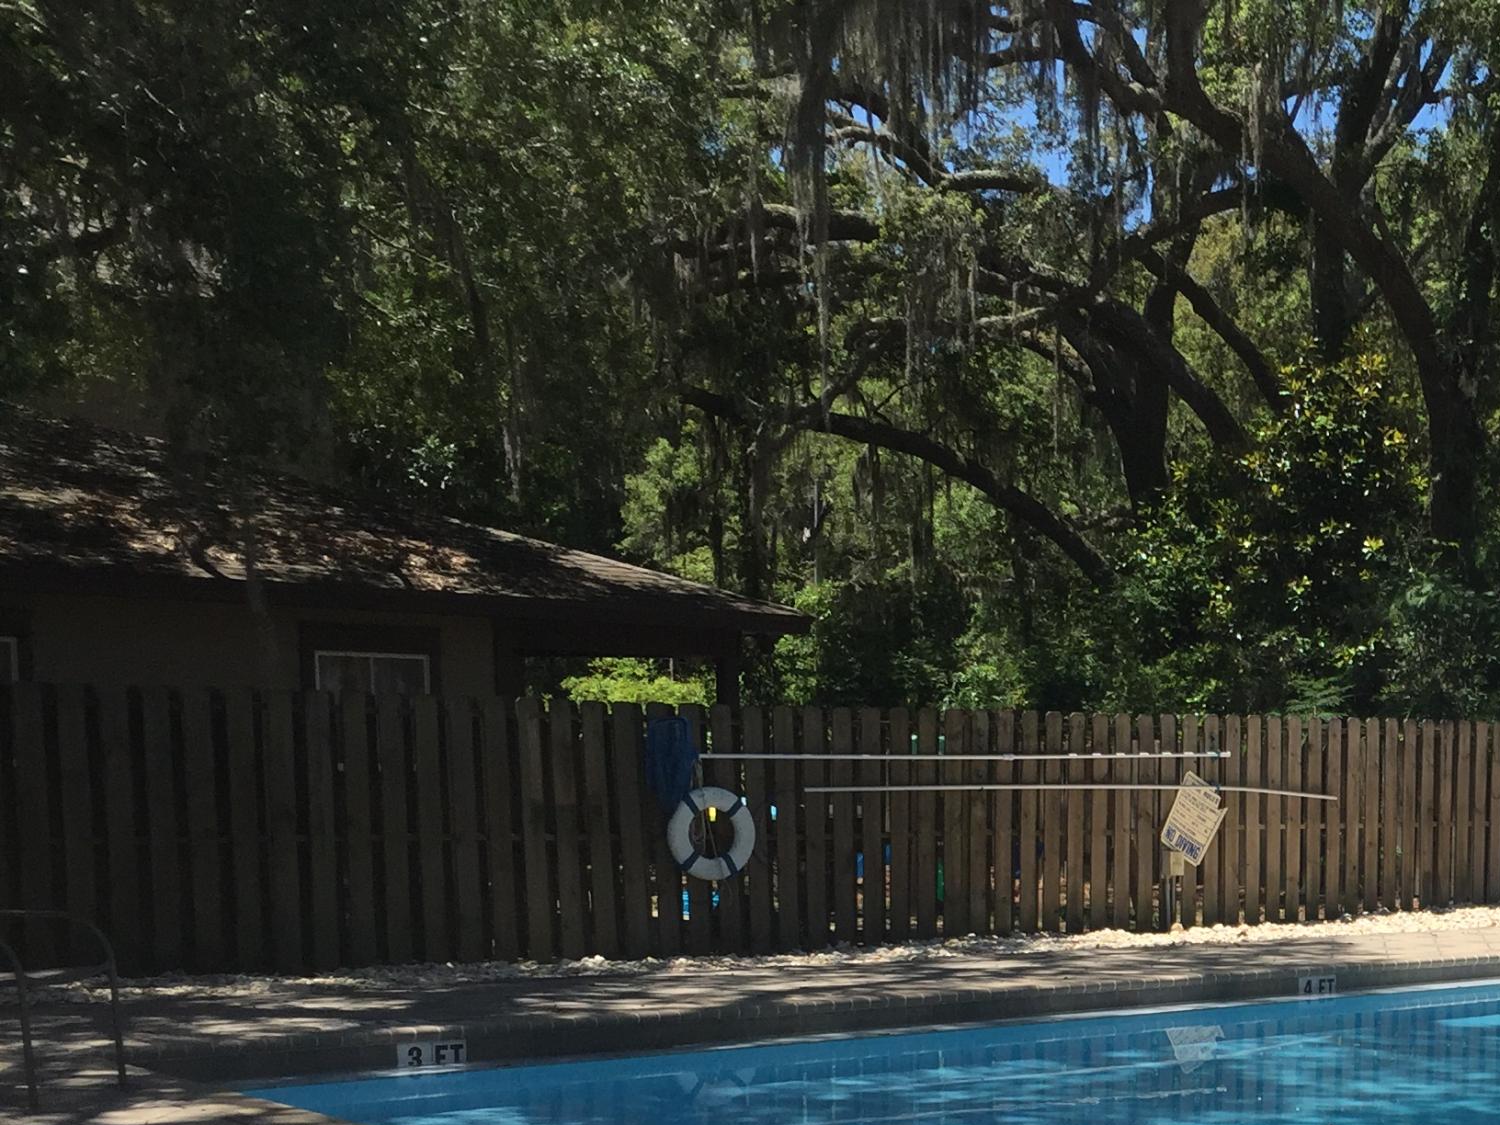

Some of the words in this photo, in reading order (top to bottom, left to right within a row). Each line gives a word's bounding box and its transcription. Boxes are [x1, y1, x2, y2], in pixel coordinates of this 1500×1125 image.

[1165, 826, 1177, 842] NO
[1175, 834, 1201, 860] DIVING
[1304, 980, 1312, 993] 4
[1318, 978, 1335, 994] FT
[408, 1046, 423, 1066] 3
[434, 1044, 463, 1065] FT
